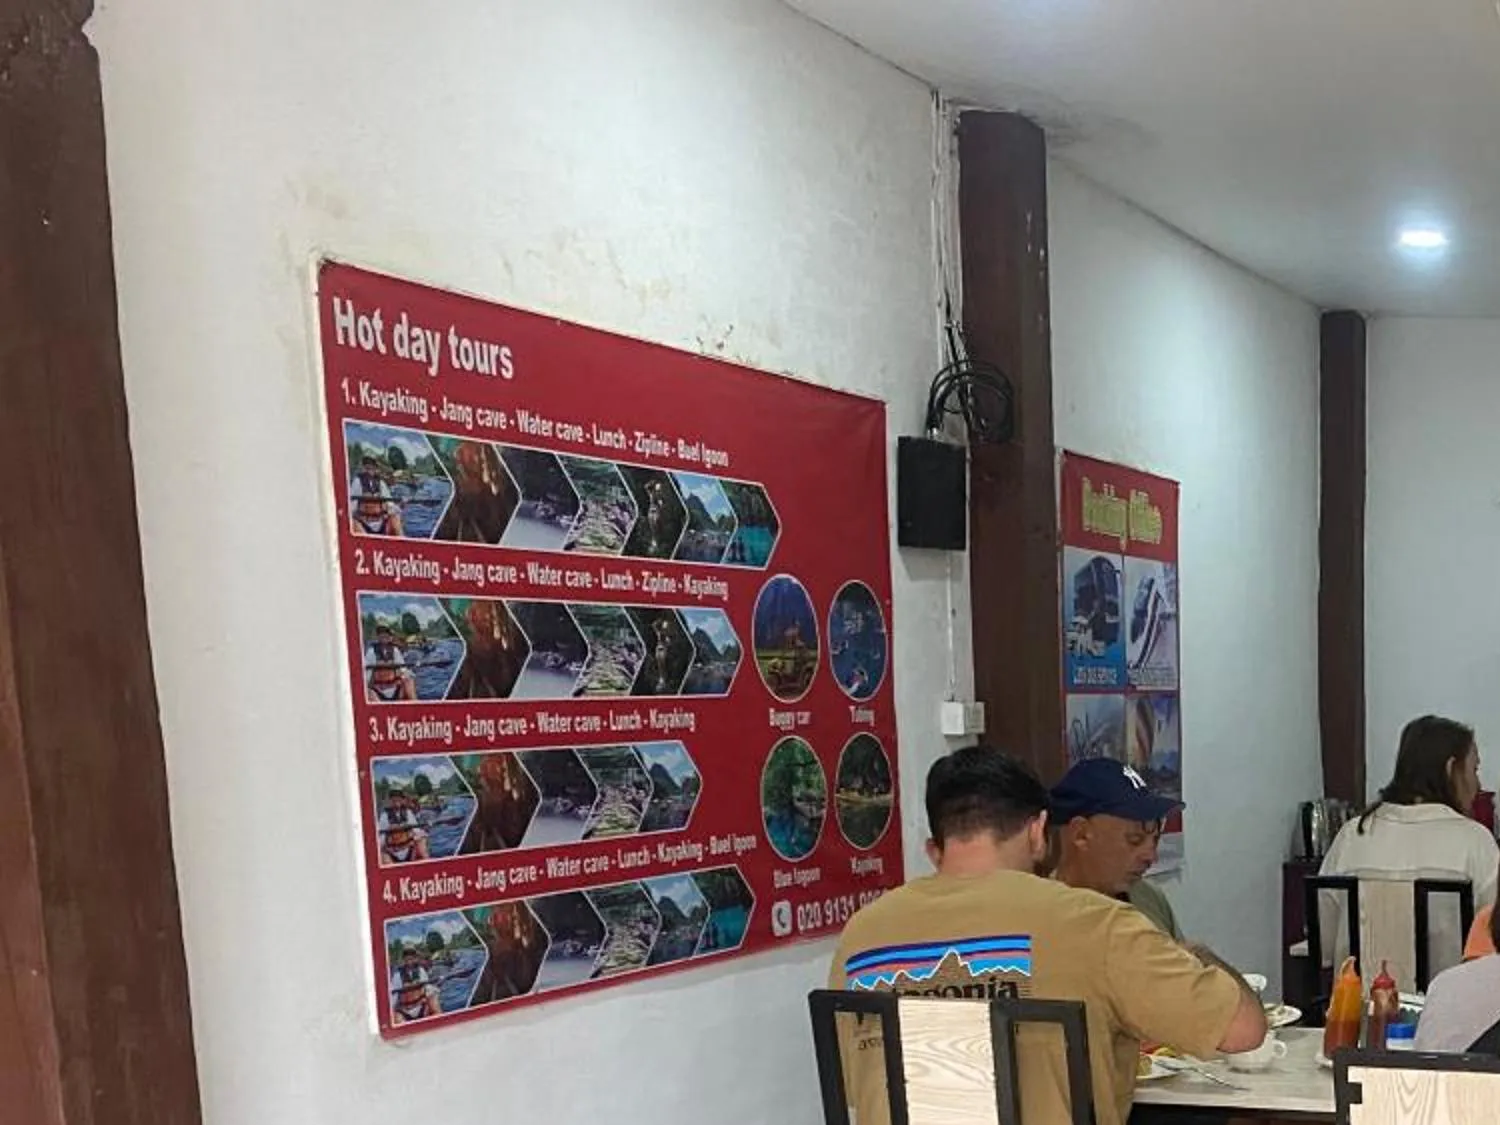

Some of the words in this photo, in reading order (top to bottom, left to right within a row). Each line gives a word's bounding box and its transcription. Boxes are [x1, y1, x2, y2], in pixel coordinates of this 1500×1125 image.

[333, 296, 387, 355] Hot
[393, 311, 441, 377] day
[448, 324, 514, 379] tours
[340, 376, 356, 404] 1.
[359, 381, 429, 423] Kayaking
[439, 396, 472, 429] Jang
[476, 407, 507, 429] cave
[516, 408, 552, 437] Water
[556, 421, 584, 443] cave
[592, 423, 626, 450] Lunch
[354, 548, 370, 575] 2.
[373, 550, 440, 584] Kayaking
[452, 556, 485, 587] Jang
[487, 564, 517, 583] cave
[526, 561, 562, 585] Water
[565, 567, 593, 588] cave
[601, 567, 635, 591] Lunch
[641, 571, 676, 597] Zipline
[684, 573, 729, 601] Kayaking
[369, 716, 384, 742] 3.
[387, 716, 452, 746] Kayaking
[463, 714, 495, 743] Jang
[499, 717, 528, 736] cave
[537, 711, 571, 734] Water
[574, 713, 601, 732] cave
[609, 709, 642, 731] Lunch
[649, 708, 695, 733] Kayaking
[400, 873, 464, 905] Kayaking
[475, 867, 506, 892] Jang
[509, 863, 538, 884] cave
[546, 853, 582, 879] Water
[584, 852, 610, 872] cave
[618, 845, 651, 870] Lunch
[658, 839, 702, 867] Kayaking
